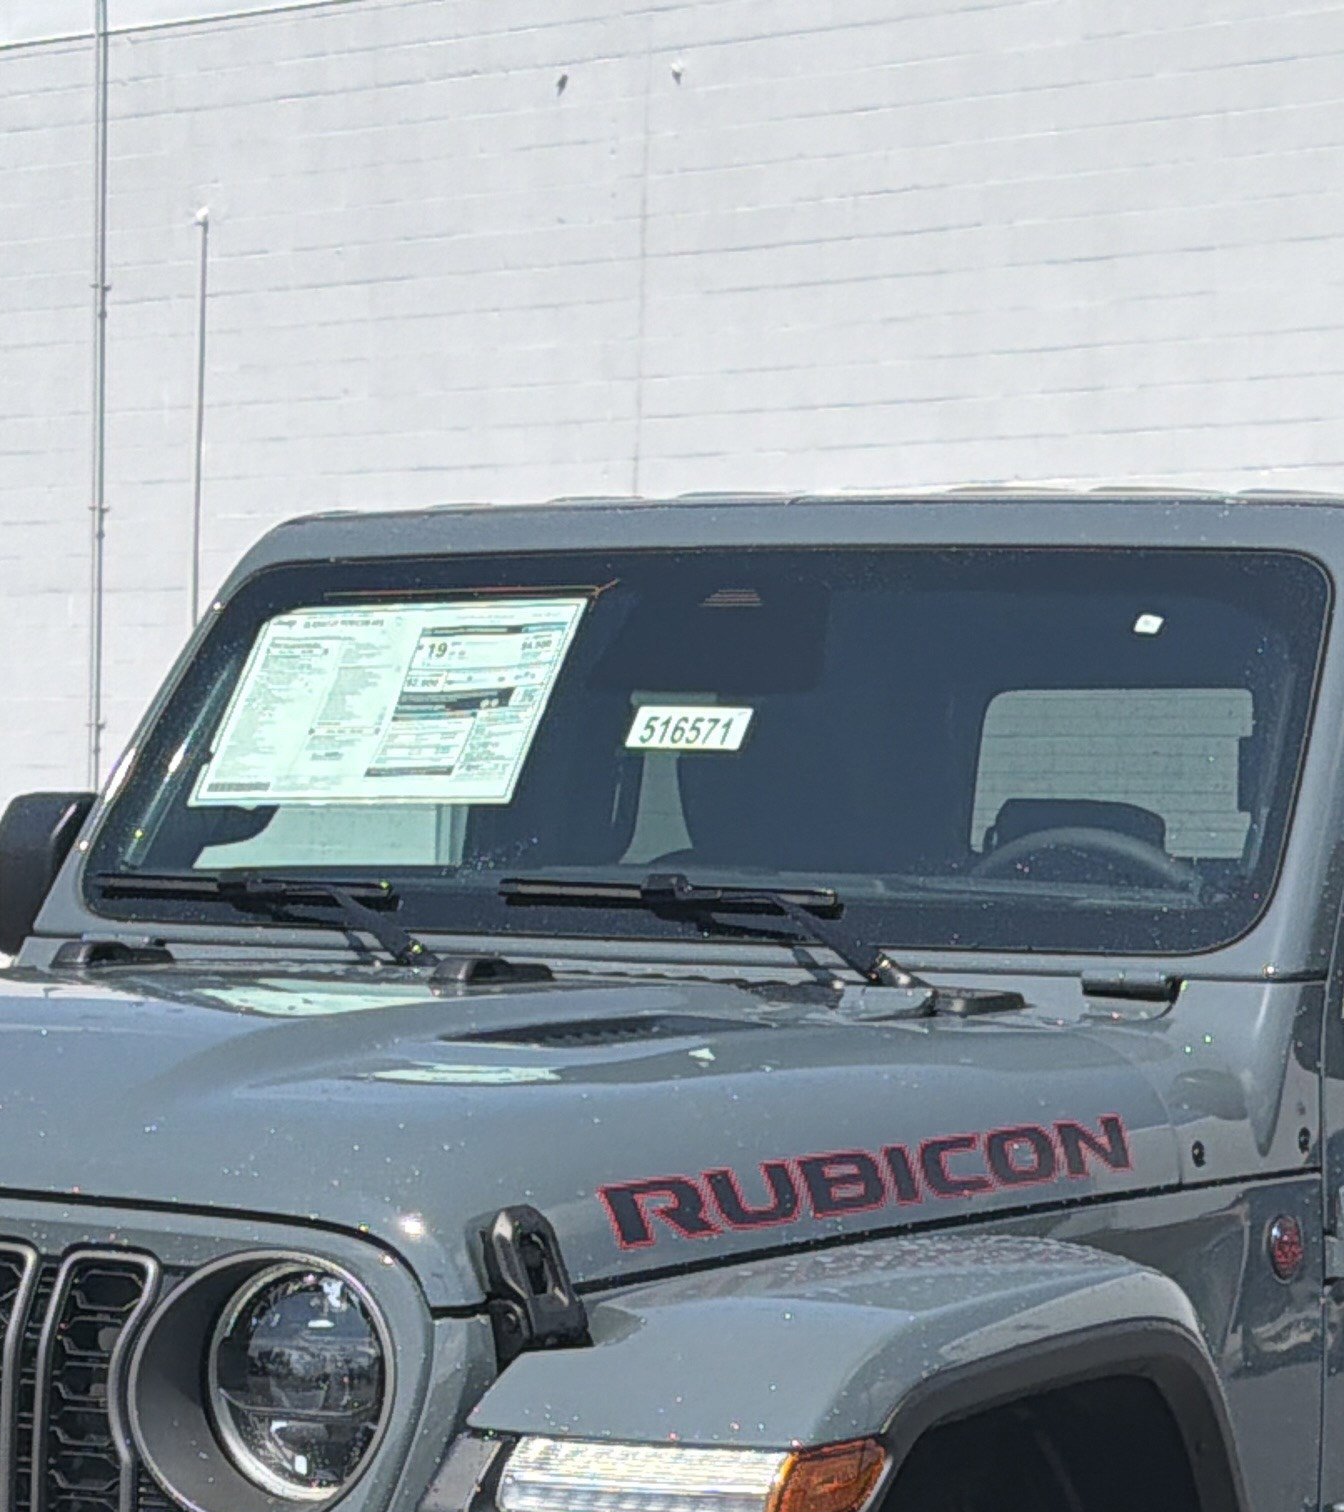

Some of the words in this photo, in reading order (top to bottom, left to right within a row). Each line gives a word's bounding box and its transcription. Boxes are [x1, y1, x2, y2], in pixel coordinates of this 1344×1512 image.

[427, 641, 449, 659] 19
[639, 716, 733, 745] 516571
[598, 1114, 1132, 1249] RUBICON
